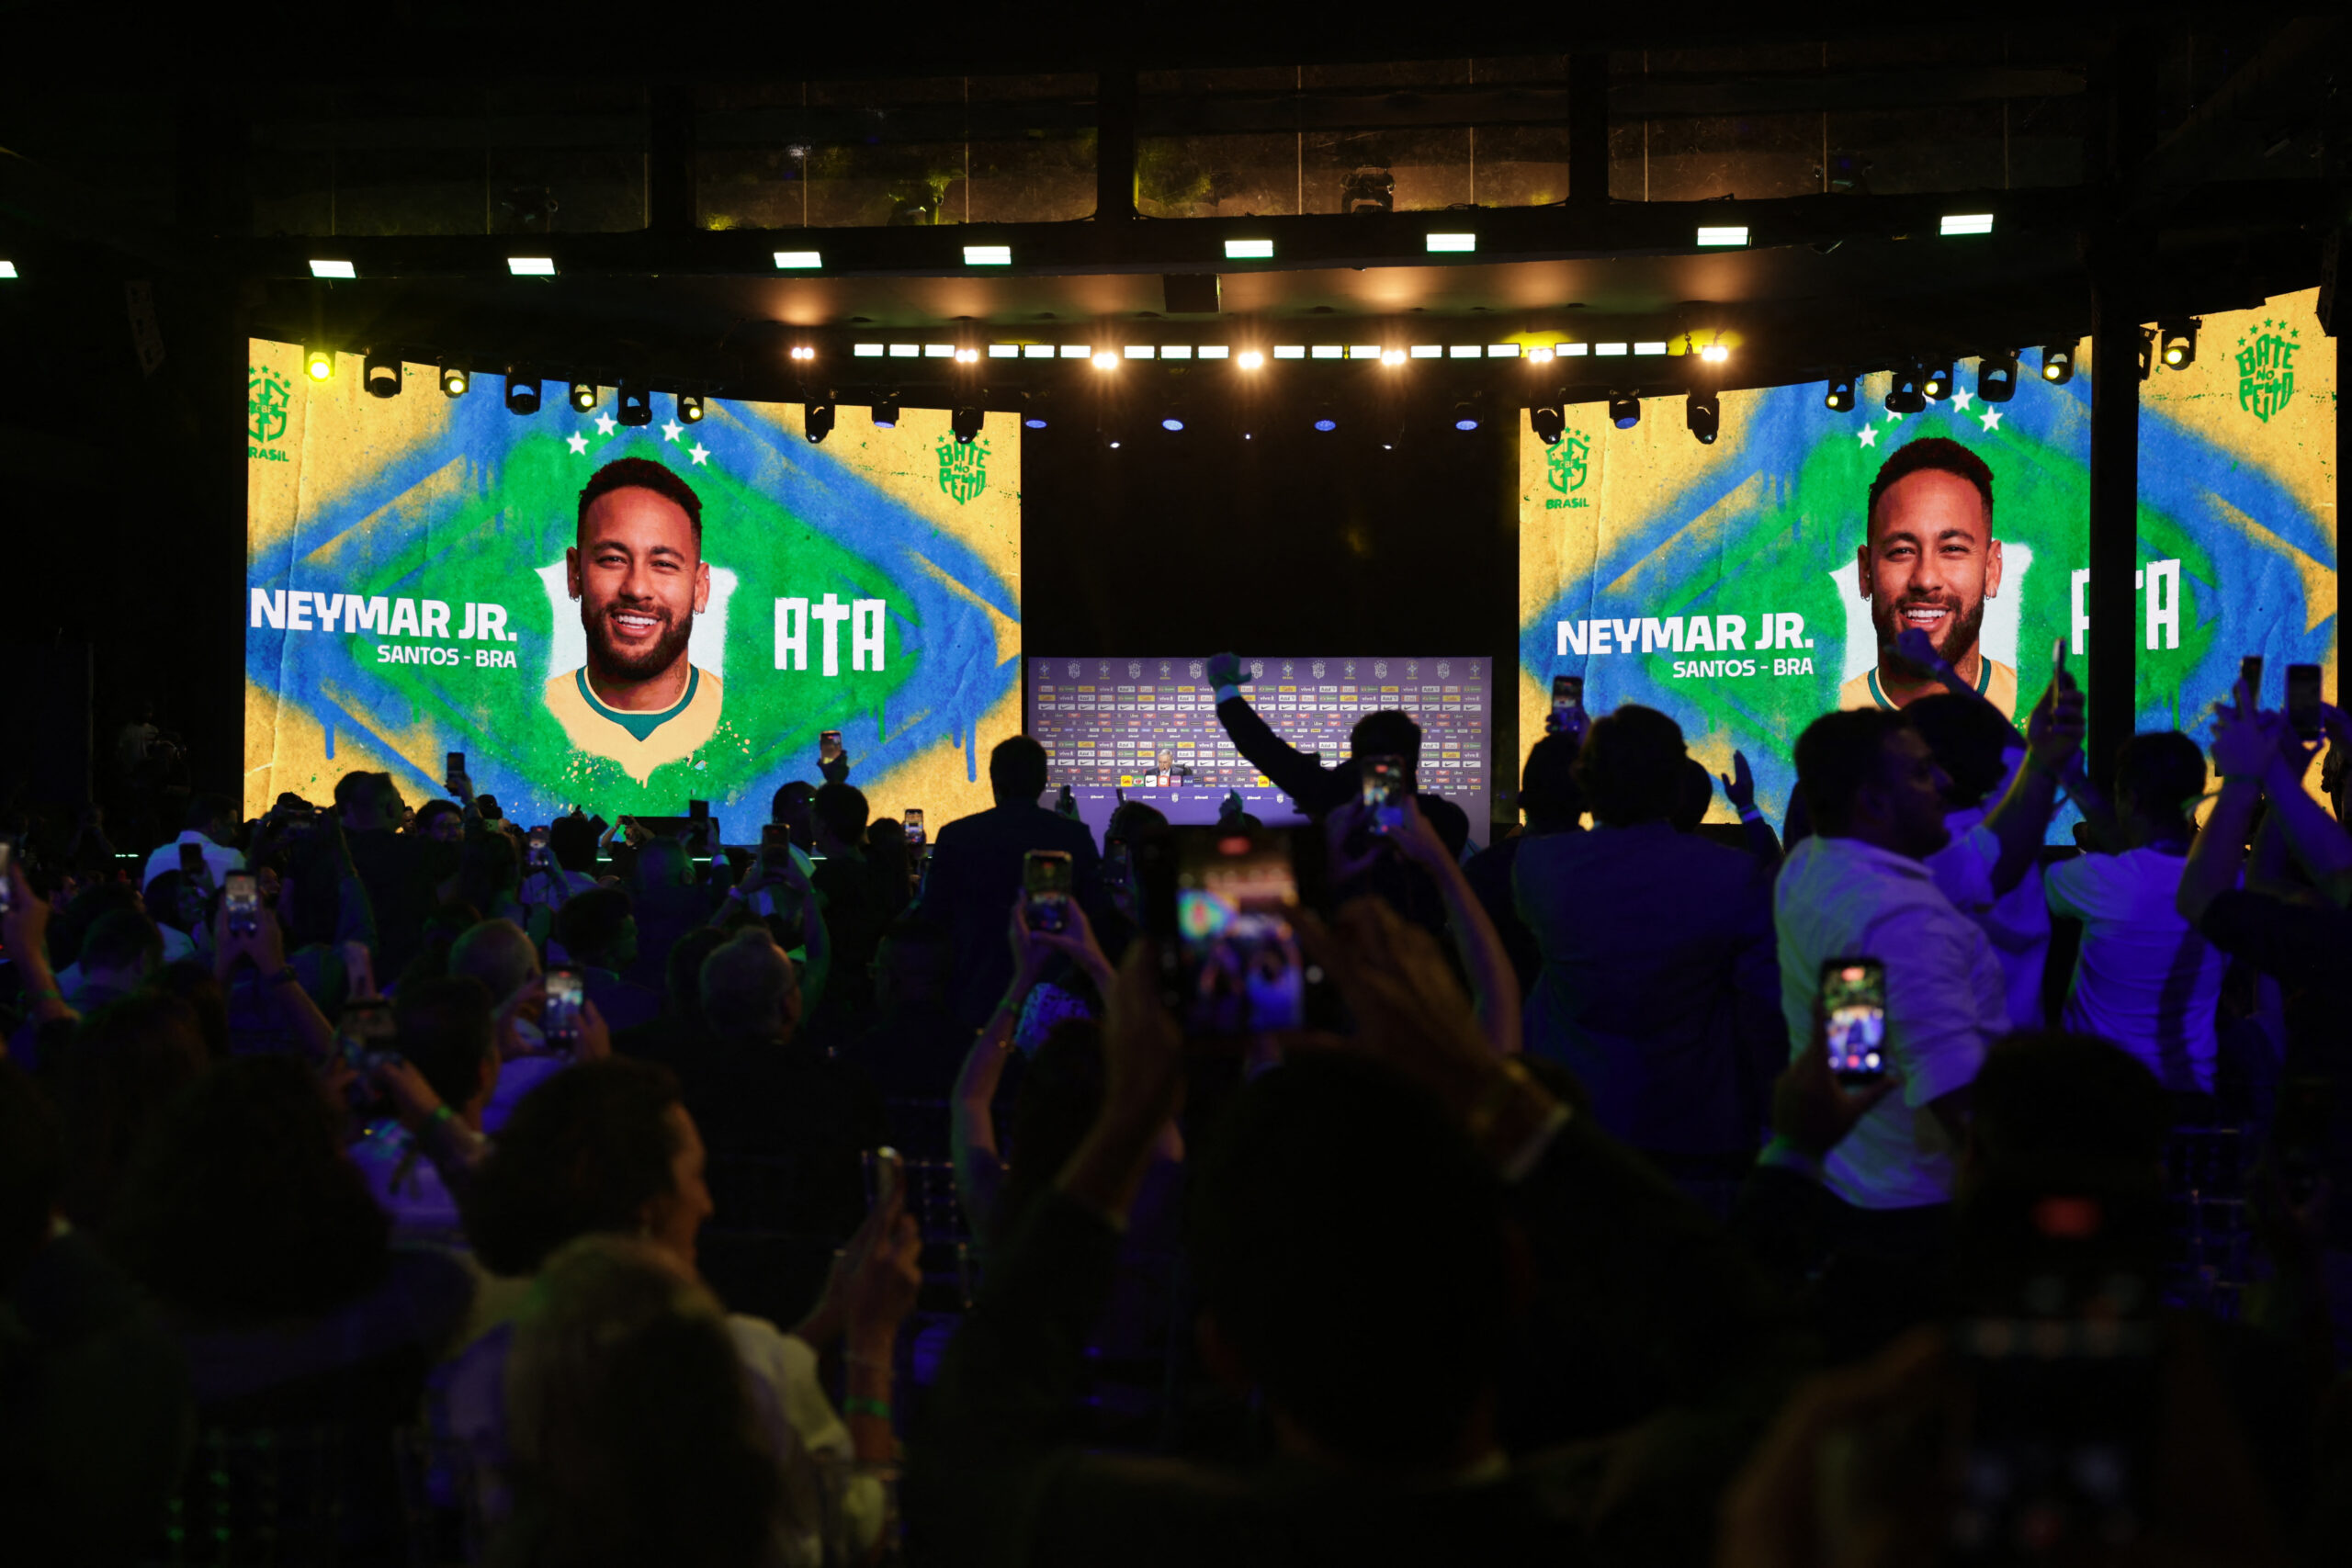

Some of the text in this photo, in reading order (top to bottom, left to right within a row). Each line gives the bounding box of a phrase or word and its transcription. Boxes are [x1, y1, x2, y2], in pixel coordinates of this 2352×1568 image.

[2234, 333, 2301, 378] BATE
[2256, 366, 2275, 380] NO
[2239, 372, 2293, 423] PEITO
[248, 446, 289, 462] RASIL
[954, 460, 970, 473] NO
[939, 468, 986, 505] PEITO
[1545, 498, 1589, 510] BRASIL
[251, 588, 517, 641] NEYMAR JR.
[775, 592, 887, 676] ATA
[1557, 612, 1814, 655] NEYMAR JR.
[377, 645, 459, 666] SANTOS
[476, 649, 517, 668] BRA
[1673, 660, 1756, 678] SANTOS
[1773, 658, 1814, 675] BRA
